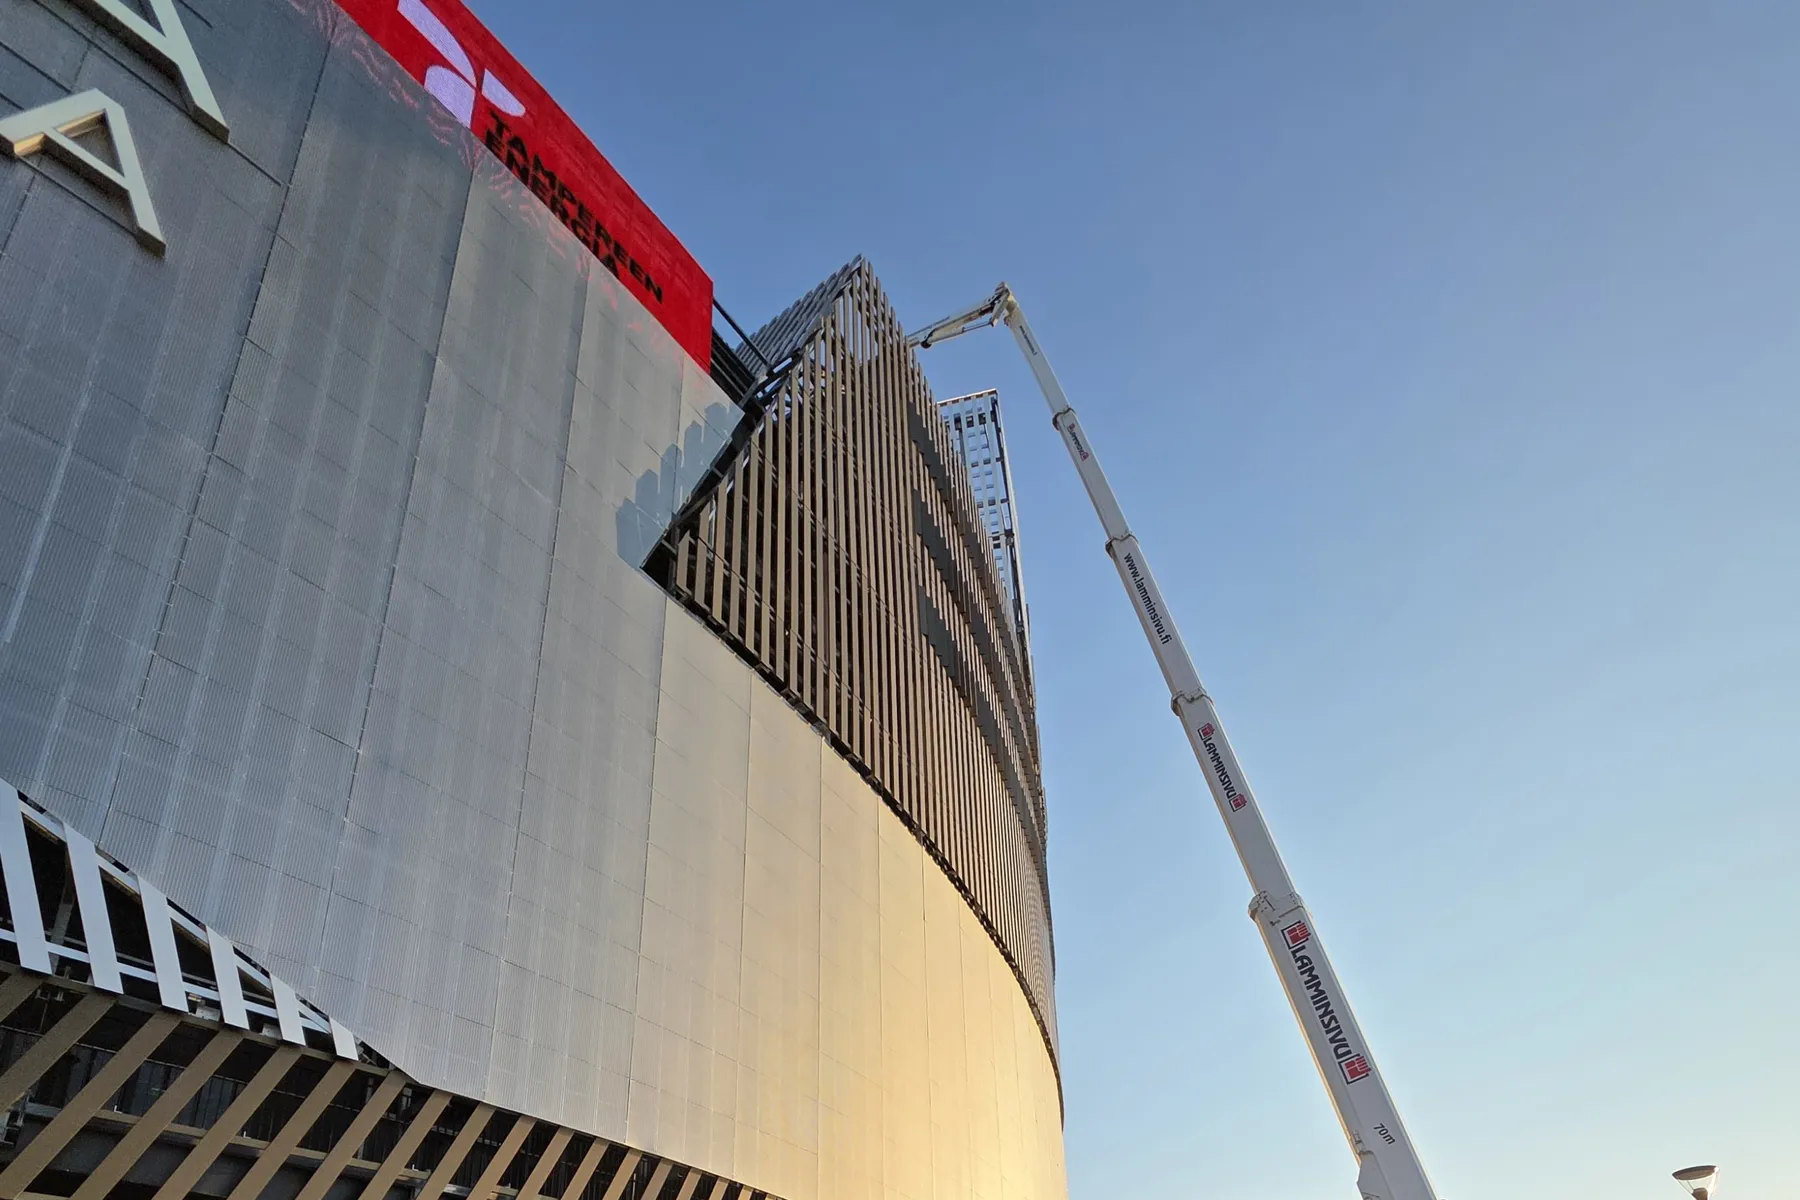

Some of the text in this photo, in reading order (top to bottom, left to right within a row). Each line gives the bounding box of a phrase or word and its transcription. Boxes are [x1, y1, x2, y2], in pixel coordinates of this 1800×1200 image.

[486, 128, 620, 279] ENERGIA
[489, 109, 664, 304] TAMPEREEN
[1124, 553, 1172, 645] www.lamminsivu.fi
[1203, 737, 1237, 799] LAMMINSIVU
[1291, 945, 1352, 1060] LAMMINSIVU
